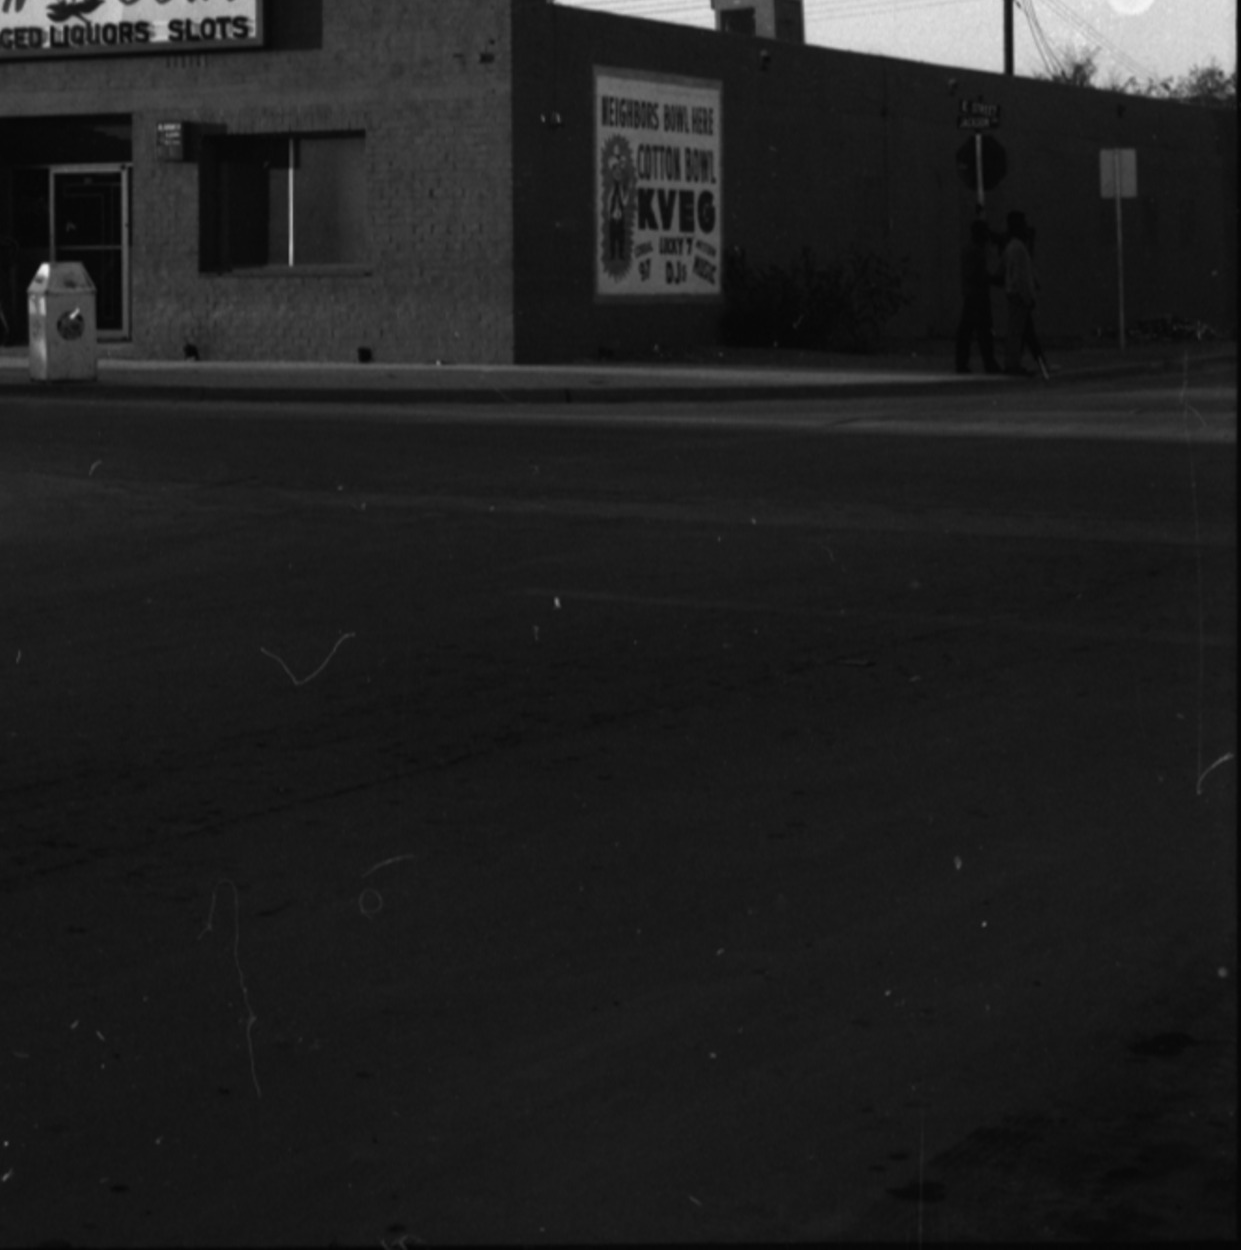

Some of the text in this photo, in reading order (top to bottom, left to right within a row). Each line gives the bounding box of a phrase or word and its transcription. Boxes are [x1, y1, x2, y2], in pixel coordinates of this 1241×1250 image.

[49, 21, 153, 50] LIQUORS
[167, 16, 251, 42] SLOTS
[601, 94, 714, 137] NEIGHBORS BOWL HERE
[637, 143, 716, 184] COTTON BOWL
[637, 187, 716, 234] KVEG
[659, 236, 684, 255] LUCKY
[685, 236, 694, 255] 7
